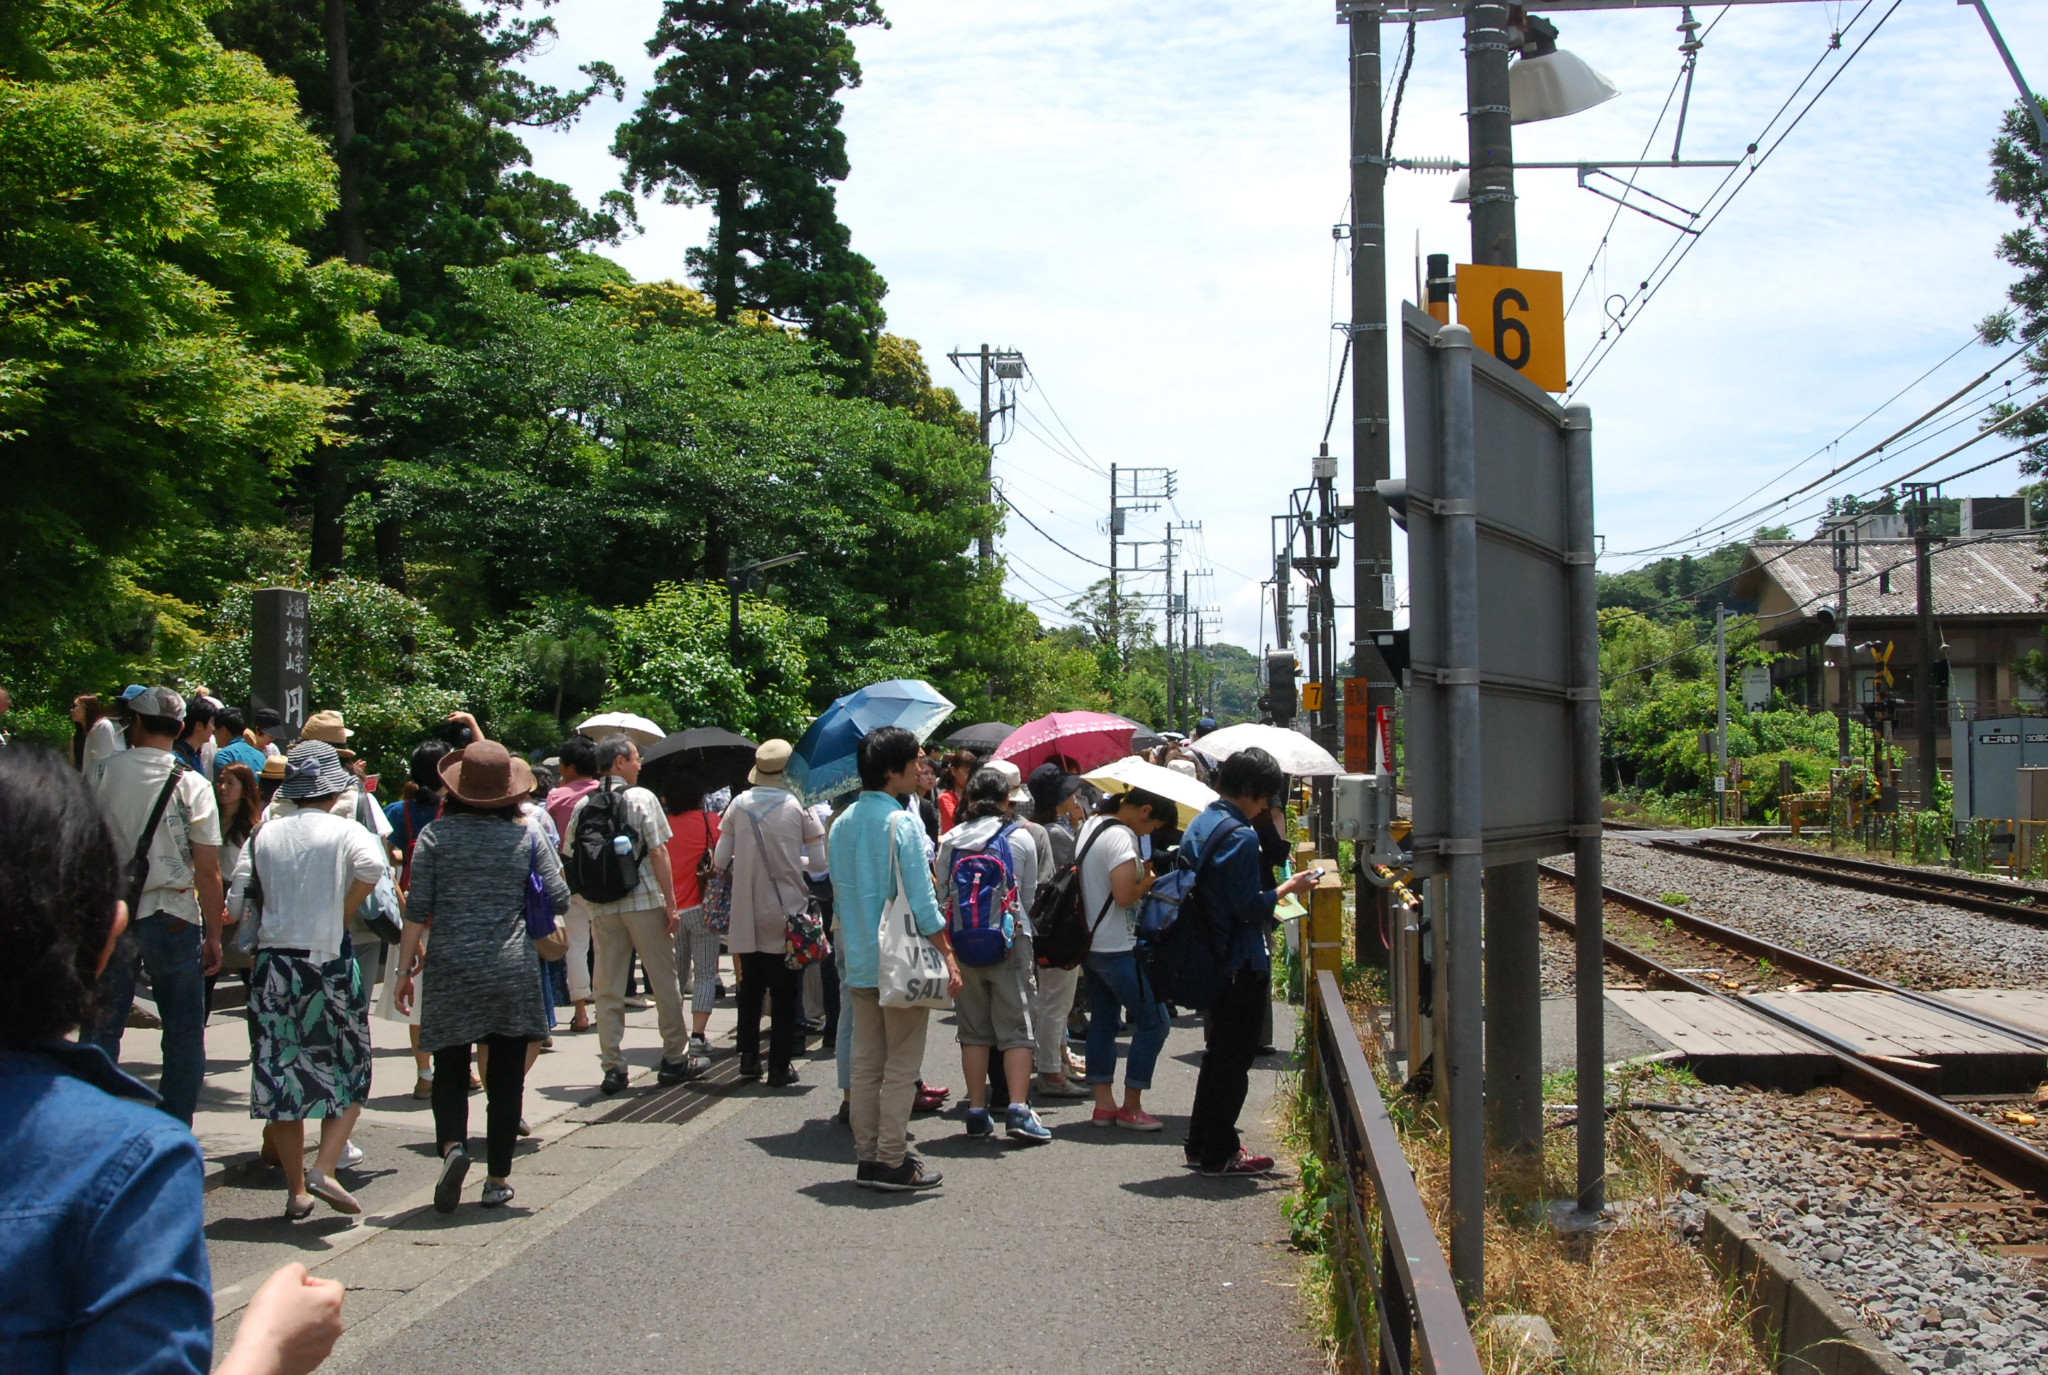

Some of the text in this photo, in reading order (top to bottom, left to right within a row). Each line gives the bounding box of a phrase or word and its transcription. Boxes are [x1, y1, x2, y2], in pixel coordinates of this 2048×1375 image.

[1493, 287, 1531, 370] 6
[1385, 585, 1395, 598] 10
[1310, 687, 1320, 705] 7
[285, 685, 304, 744] 円
[905, 946, 943, 970] VER
[904, 978, 943, 1002] SAL
